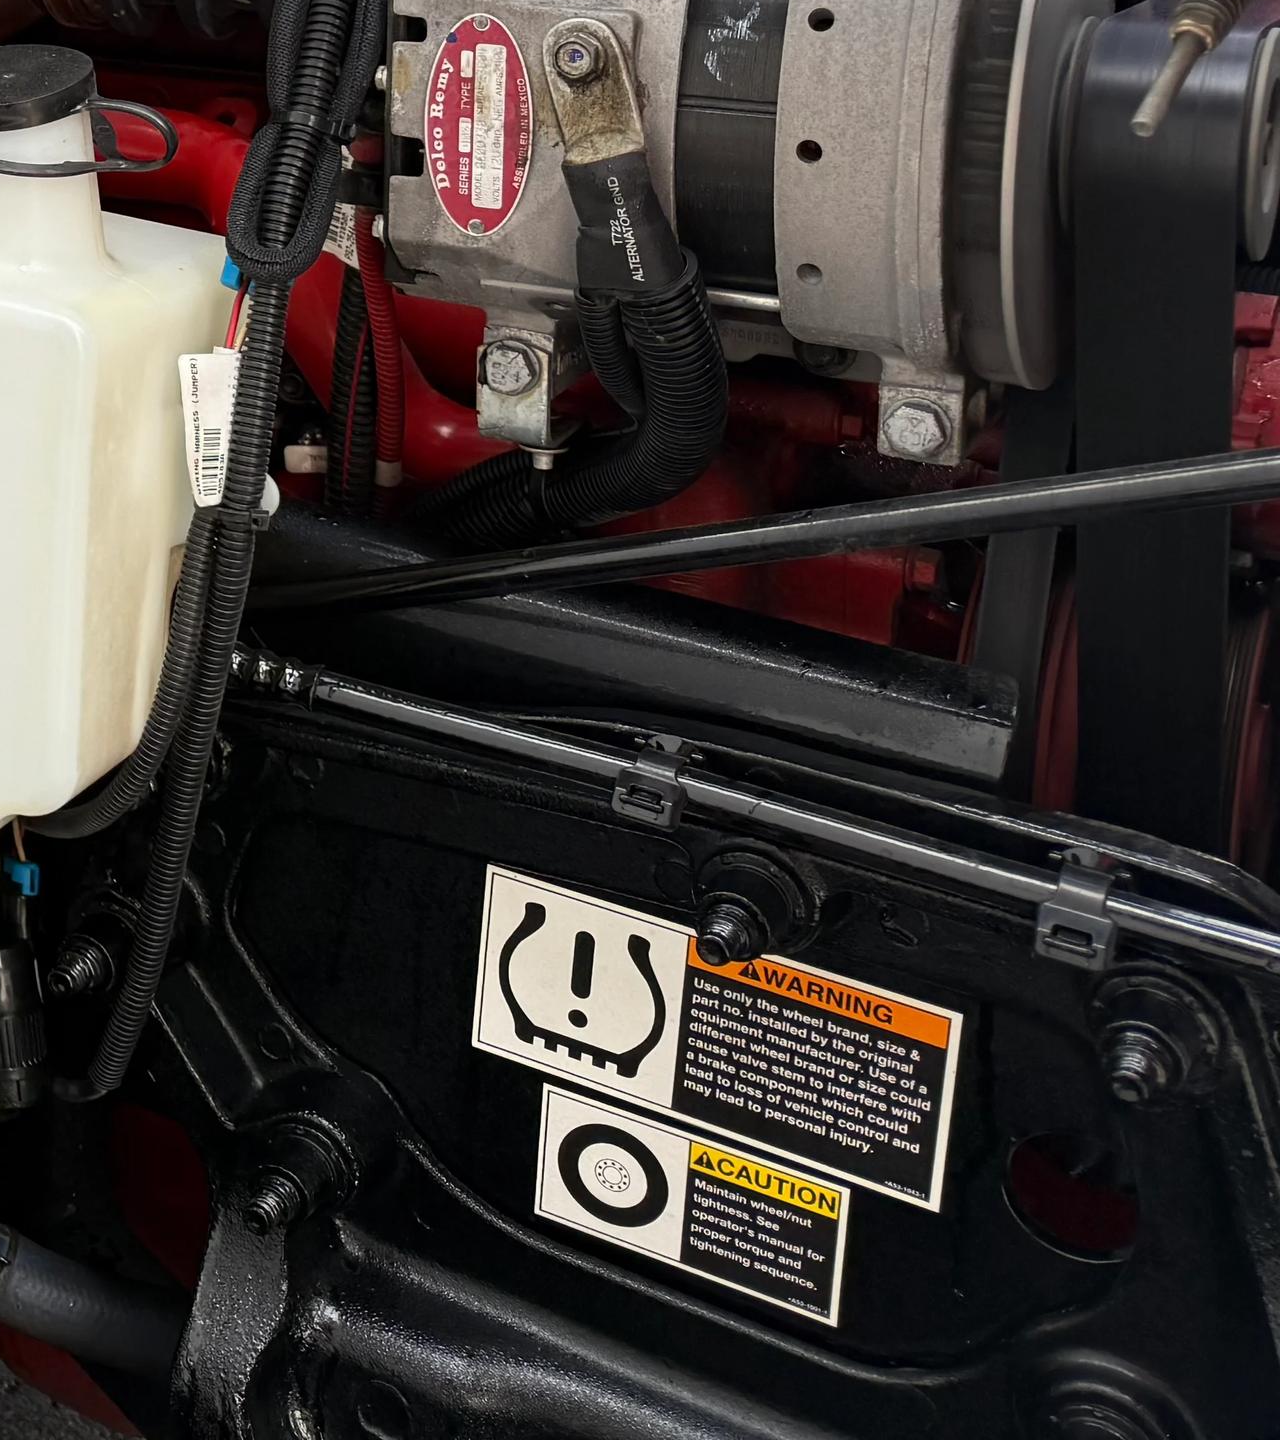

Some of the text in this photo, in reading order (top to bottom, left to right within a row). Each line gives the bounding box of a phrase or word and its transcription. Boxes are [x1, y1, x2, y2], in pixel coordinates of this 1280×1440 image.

[461, 81, 472, 110] TYPE
[516, 78, 529, 116] MEXICO
[430, 58, 455, 191] Delco Remy
[458, 157, 470, 196] SERIES
[607, 176, 645, 282] ALTERNATOR GND
[609, 219, 624, 246] T722
[189, 357, 199, 404] (JUMPER)
[192, 410, 201, 453] HARNESS
[694, 977, 920, 1061] Use only the wheel brand, size &
[762, 965, 894, 1026] WARNING
[690, 1008, 928, 1095] equipment manufacturer. Use of a
[692, 992, 914, 1074] part no. installed by the original
[686, 1050, 909, 1135] a brake component which could
[688, 1037, 922, 1124] cause valve stem to interfere with
[689, 1021, 931, 1111] different wheel brand or size could
[684, 1078, 875, 1154] may lead to personal injury.
[685, 1063, 920, 1154] lead to loss of vehicle control and
[693, 1193, 780, 1232] tightness. See
[694, 1178, 813, 1229] Maintain wheel/nut
[716, 1158, 836, 1214] CAUTION
[689, 1235, 818, 1291] tightening sequence.
[690, 1222, 802, 1270] proper torque and
[691, 1208, 826, 1263] operator's manual for
